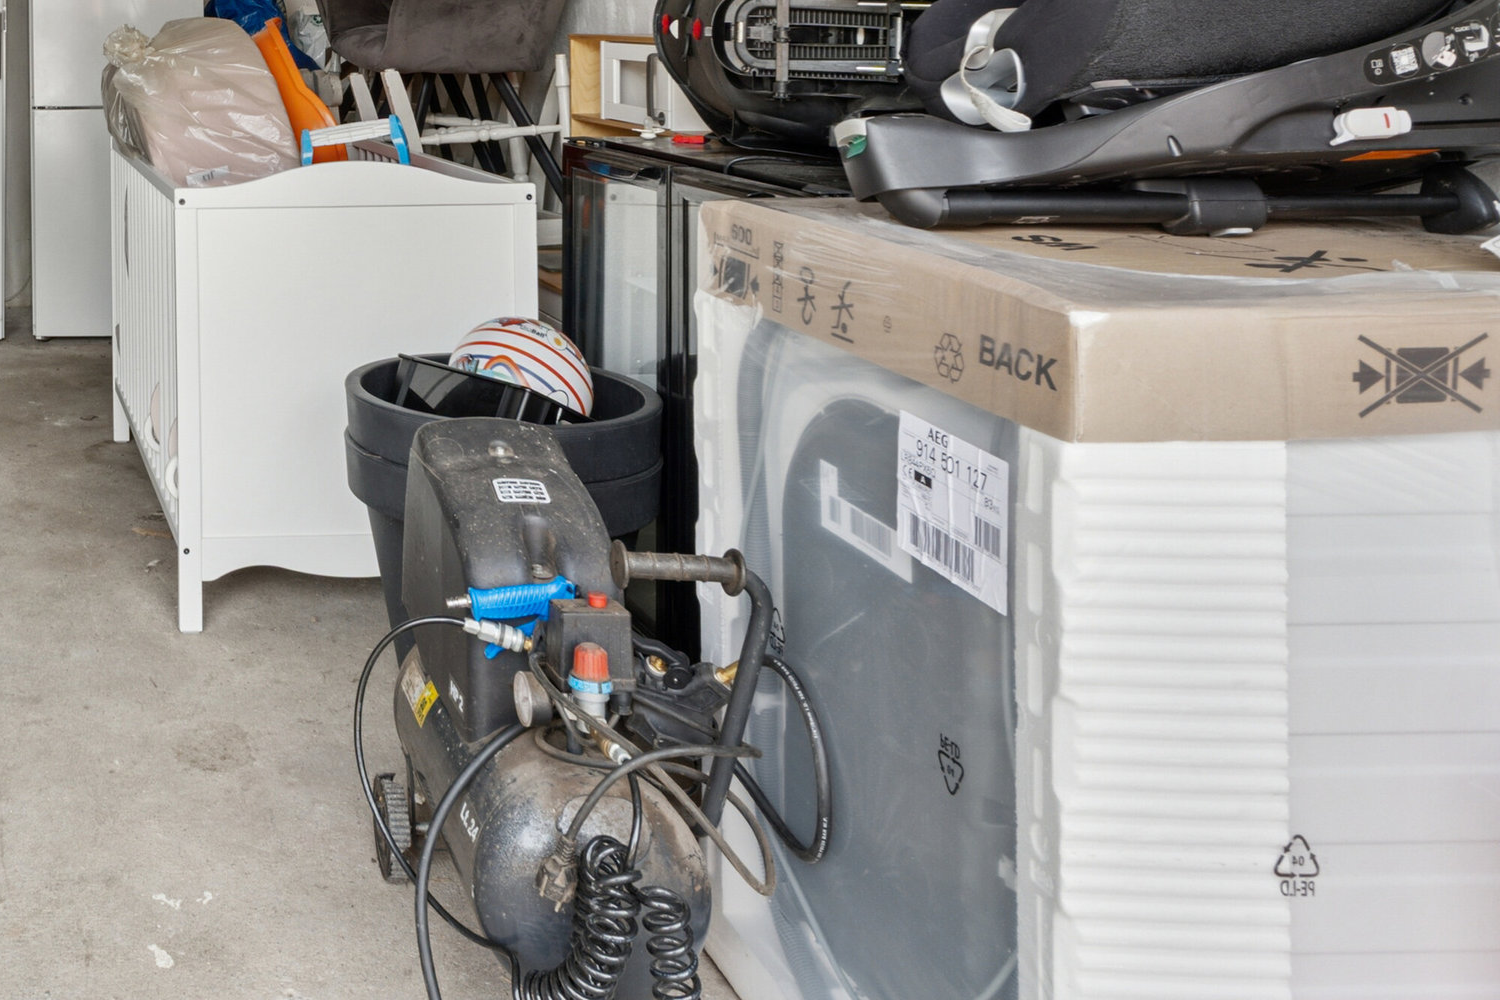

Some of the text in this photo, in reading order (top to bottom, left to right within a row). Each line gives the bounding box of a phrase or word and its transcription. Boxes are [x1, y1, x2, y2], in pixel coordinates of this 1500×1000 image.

[978, 333, 1058, 391] BACK
[927, 428, 949, 449] AEG
[916, 439, 988, 491] 914 501 127
